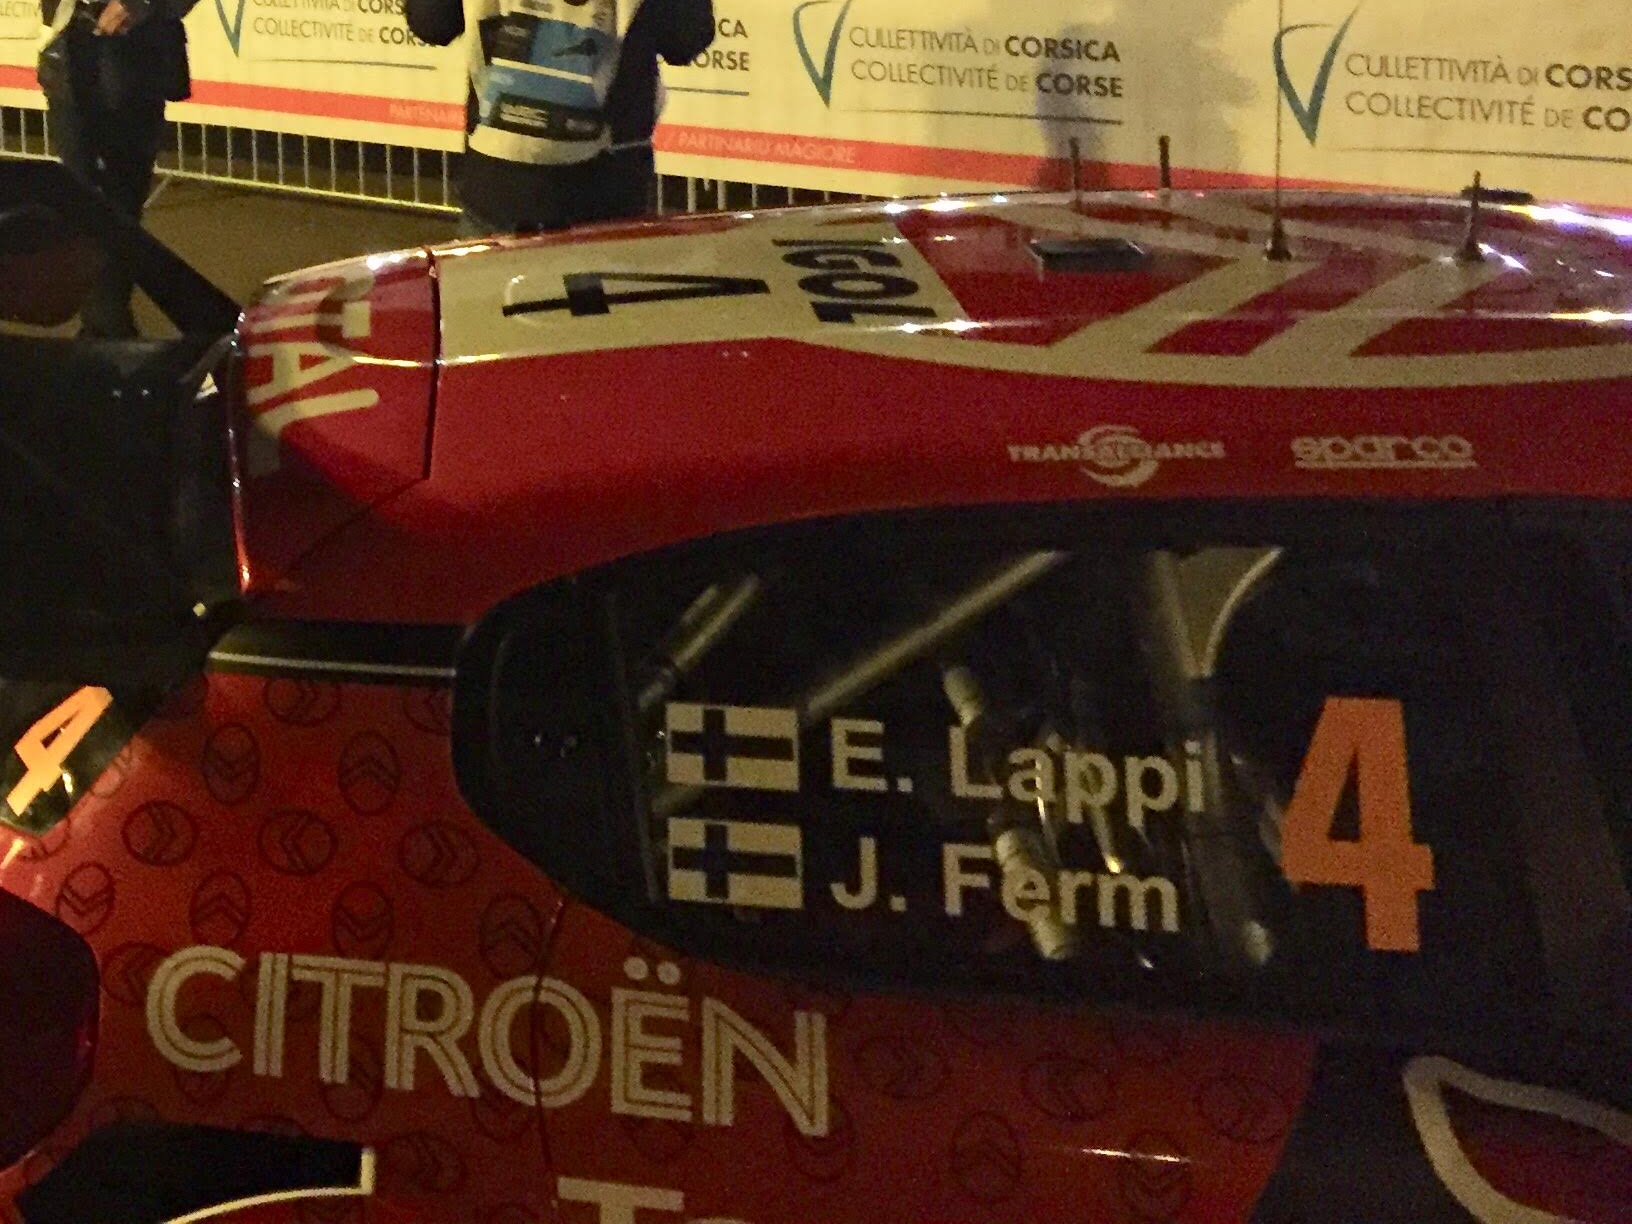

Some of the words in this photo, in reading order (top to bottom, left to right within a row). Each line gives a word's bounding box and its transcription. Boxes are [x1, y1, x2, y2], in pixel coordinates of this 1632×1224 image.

[253, 16, 353, 42] COLLECTIVITÉ
[848, 26, 979, 54] CULLETTIVITÀ
[1004, 35, 1121, 62] CORSICA
[693, 49, 750, 72] ORSE
[850, 58, 1000, 91] COLLECTIVITÉ
[1005, 75, 1029, 93] DE
[1035, 72, 1124, 98] CORSE
[1345, 52, 1511, 84] CULLETTIVITÀ
[1545, 62, 1632, 92] CORS
[1345, 90, 1535, 127] COLLECTIVITÉ
[1544, 107, 1574, 129] DE
[503, 272, 771, 317] 4
[771, 238, 938, 324] IGOL
[1290, 433, 1476, 468] sparco
[6, 685, 113, 816] 4
[829, 718, 914, 794] E.
[946, 724, 1206, 826] Lappi
[1280, 695, 1436, 954] 4
[829, 836, 908, 913] J.
[940, 840, 1181, 934] Ferm
[145, 944, 831, 1137] CITROËN
